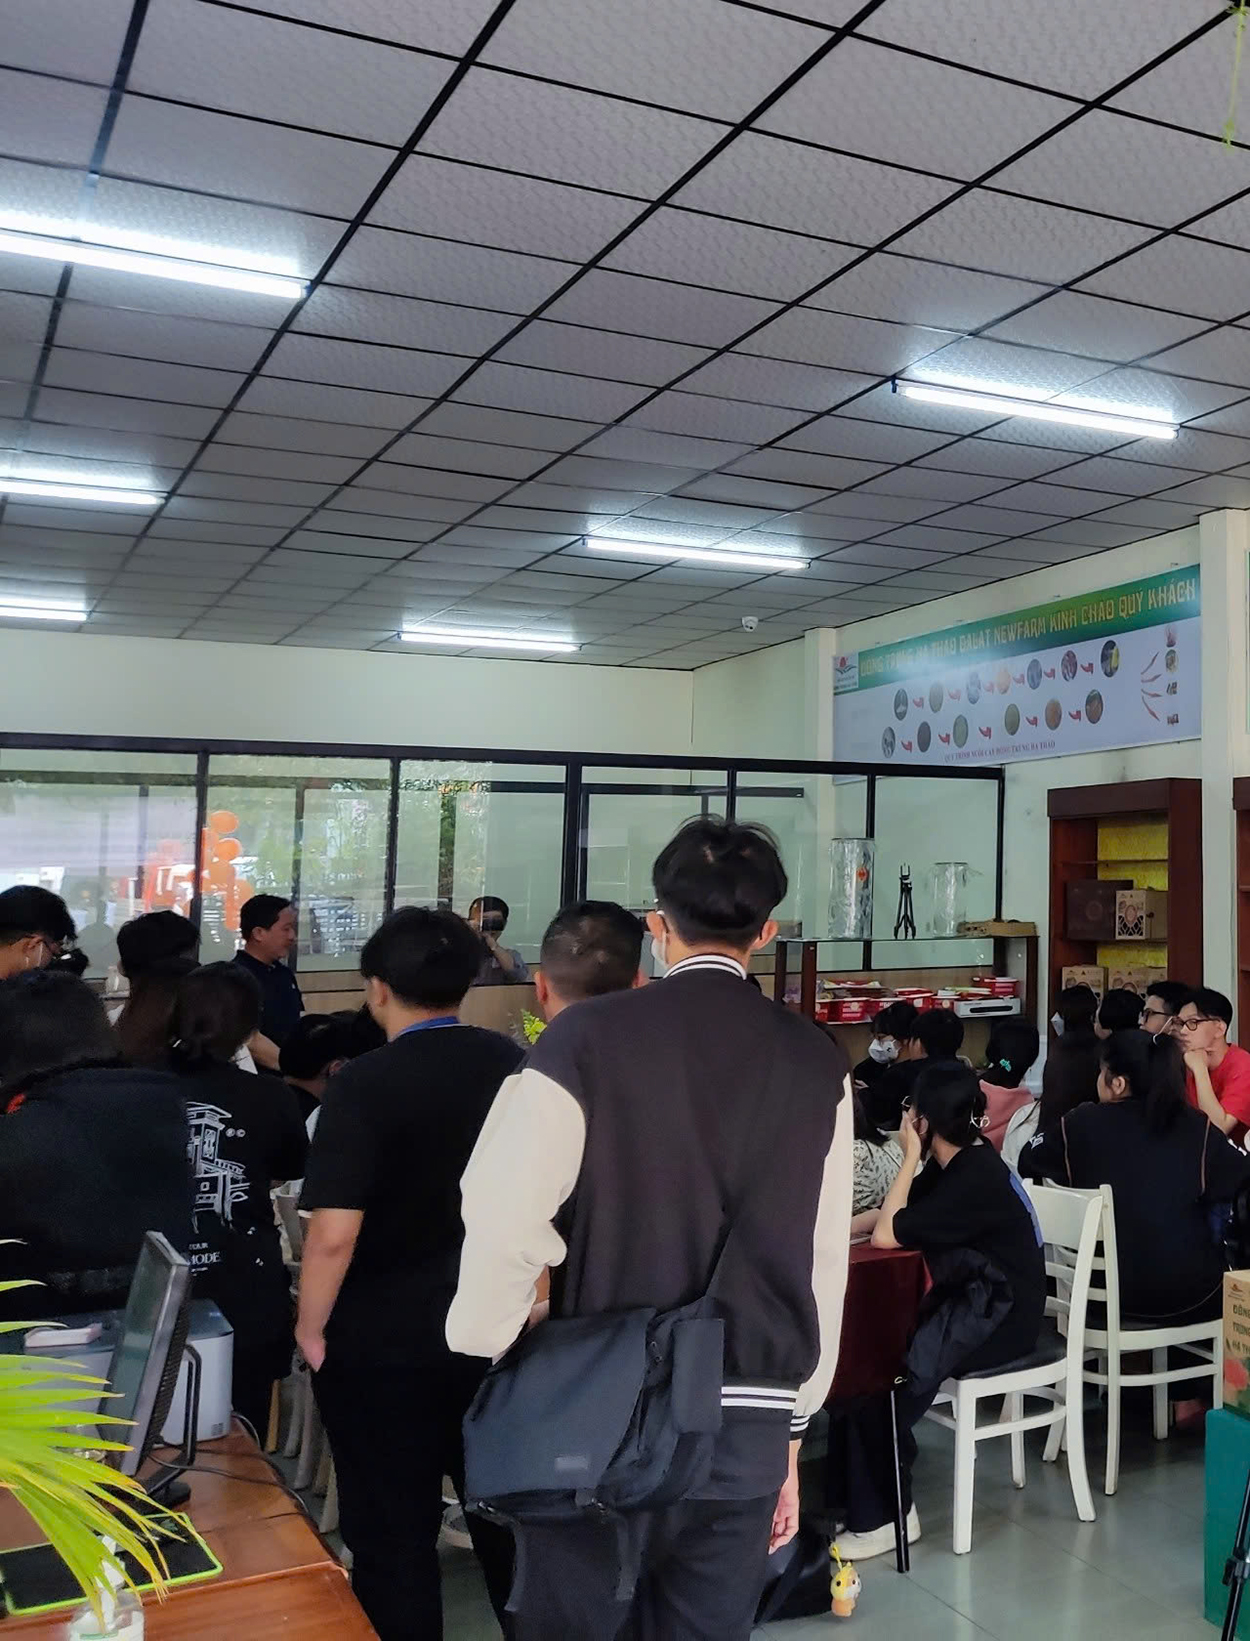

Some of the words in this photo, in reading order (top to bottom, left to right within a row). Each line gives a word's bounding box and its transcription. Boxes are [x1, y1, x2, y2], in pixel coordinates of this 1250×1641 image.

[993, 616, 1046, 644] NEWFARM
[1119, 587, 1144, 619] QUÝ
[1148, 577, 1196, 610] KHÁCH
